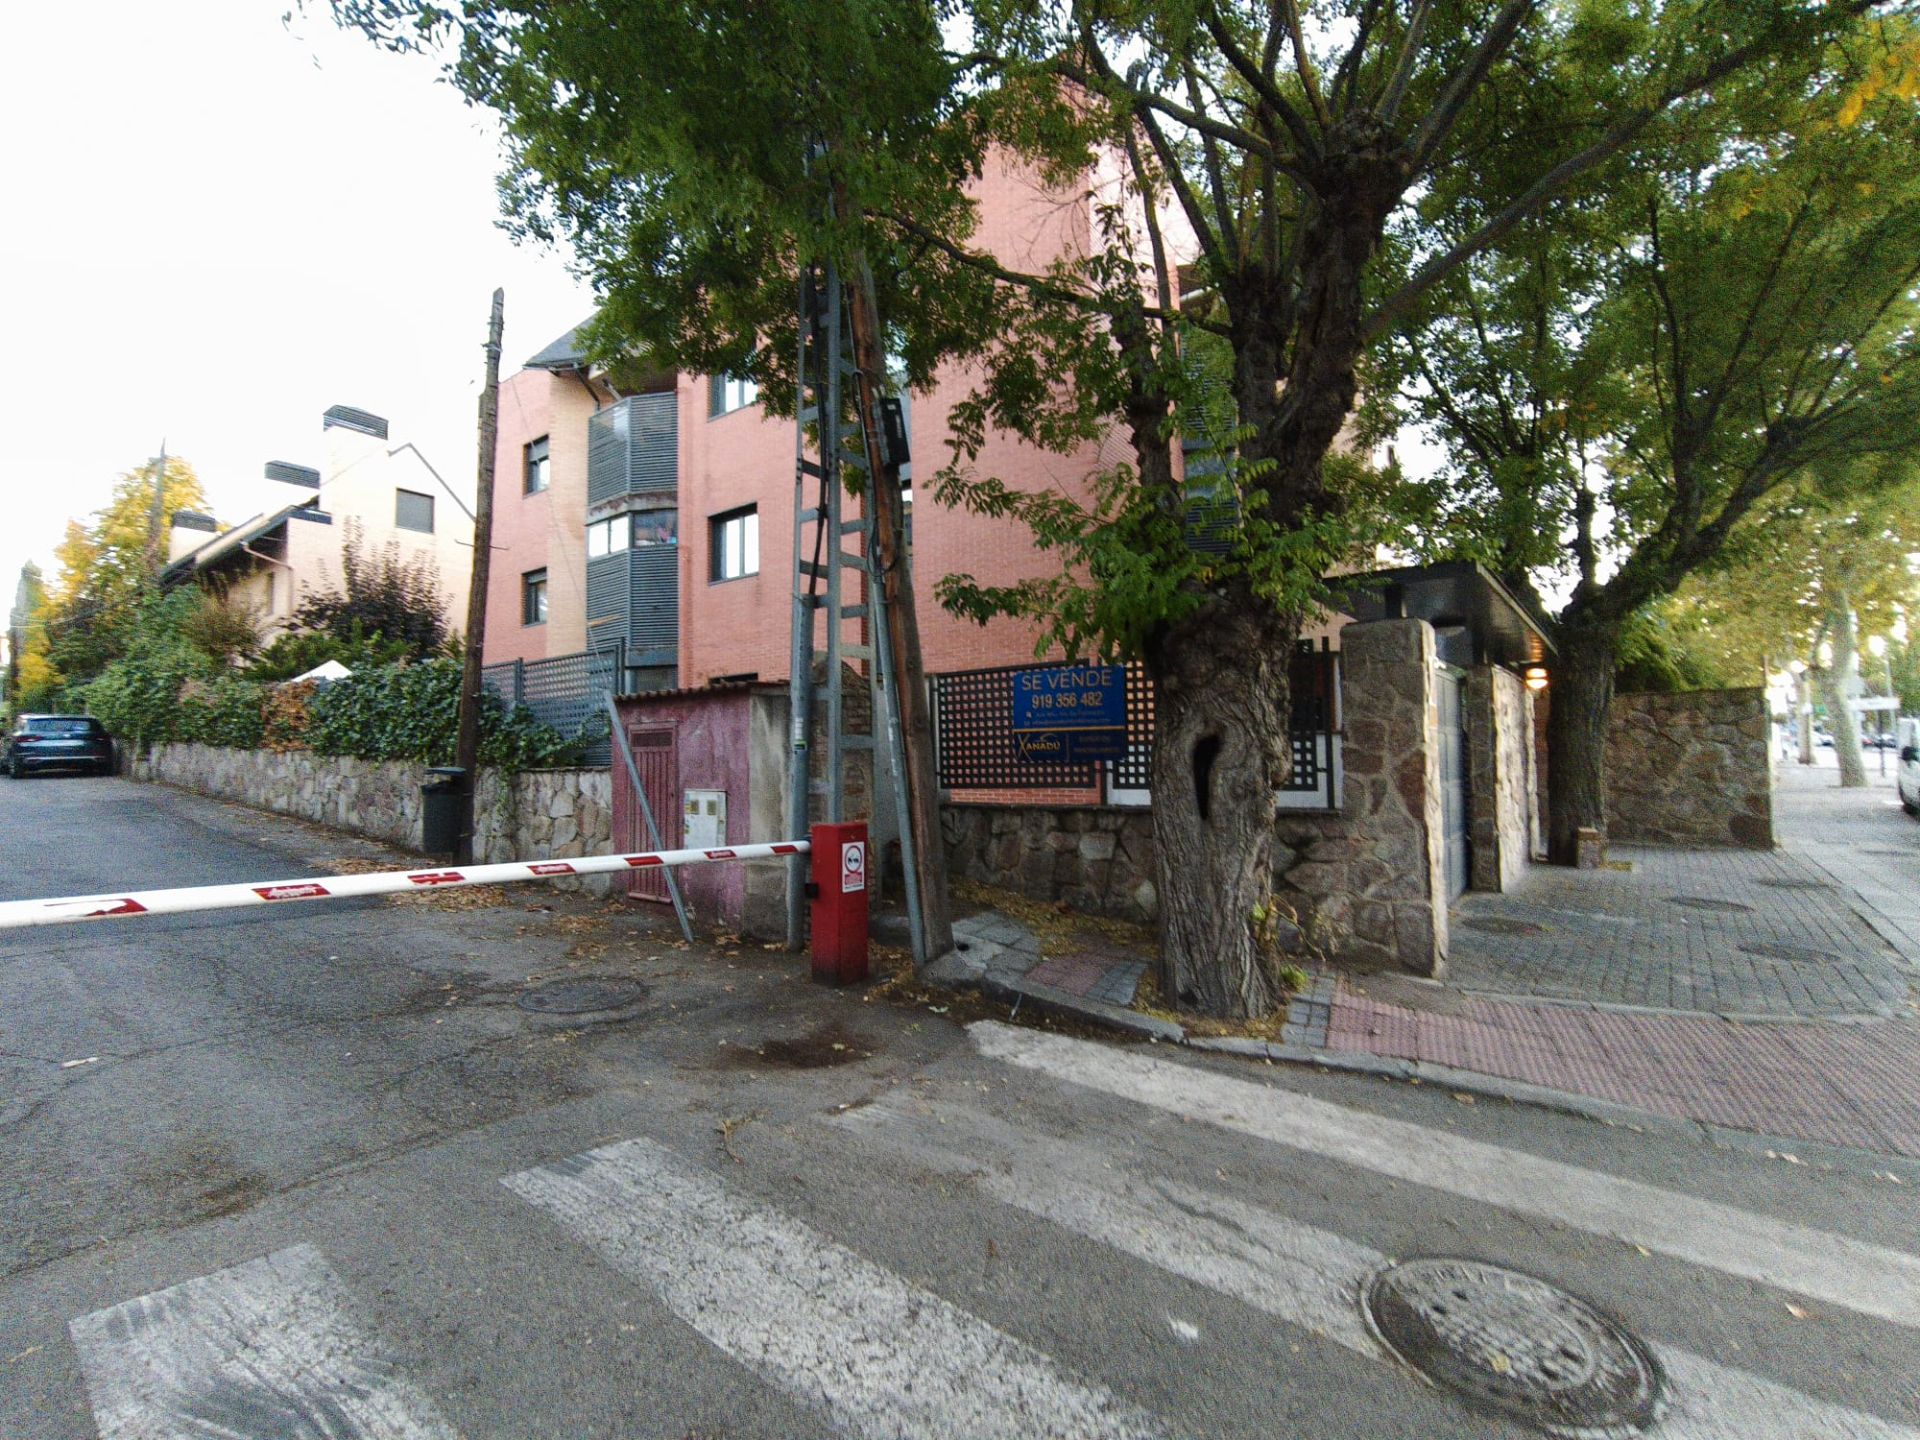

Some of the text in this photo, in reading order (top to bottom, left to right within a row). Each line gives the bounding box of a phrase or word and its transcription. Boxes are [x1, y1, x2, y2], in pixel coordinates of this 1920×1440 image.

[1021, 670, 1112, 691] SE VENDE
[1032, 691, 1103, 709] 919 356 482
